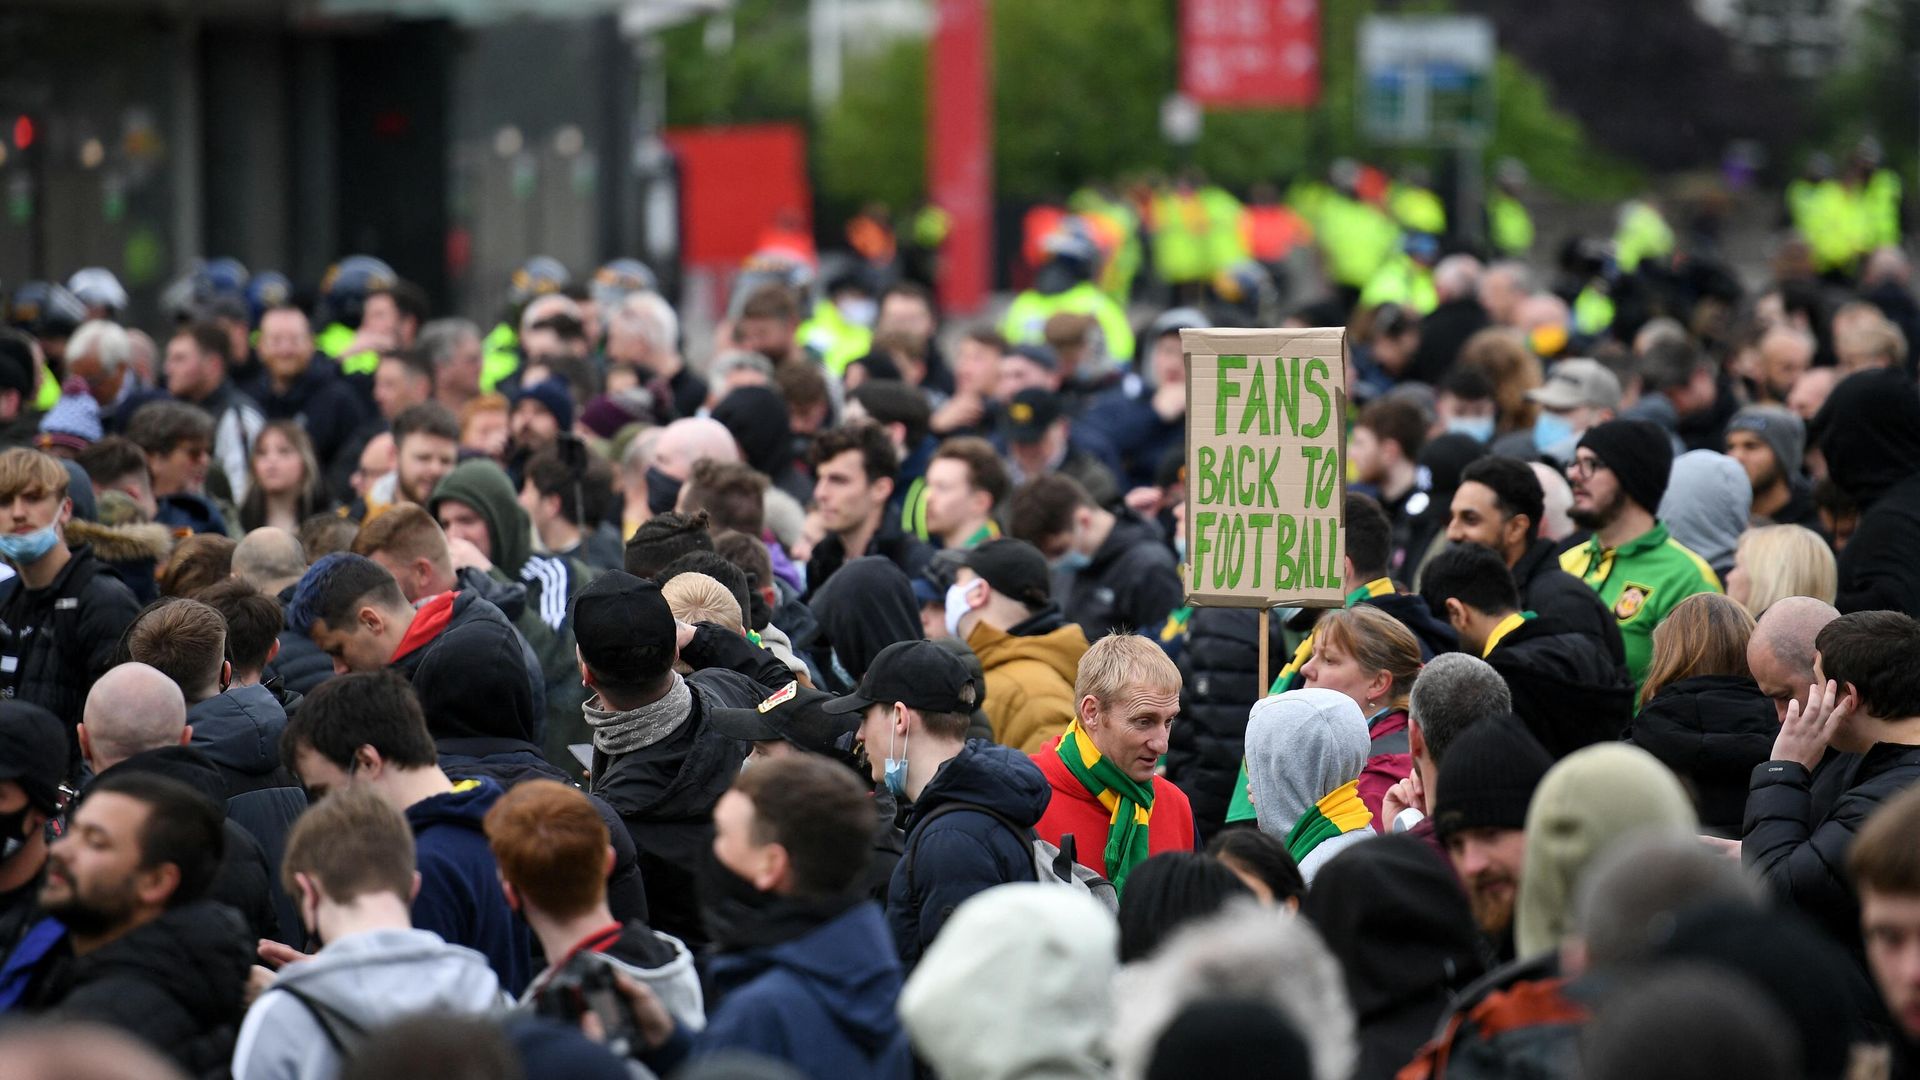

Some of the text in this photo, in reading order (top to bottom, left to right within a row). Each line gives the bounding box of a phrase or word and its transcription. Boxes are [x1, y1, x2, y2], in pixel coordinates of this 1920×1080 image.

[1215, 355, 1331, 438] FANS
[1197, 445, 1338, 508] BACK TO
[1193, 512, 1341, 591] FOOTBALL
